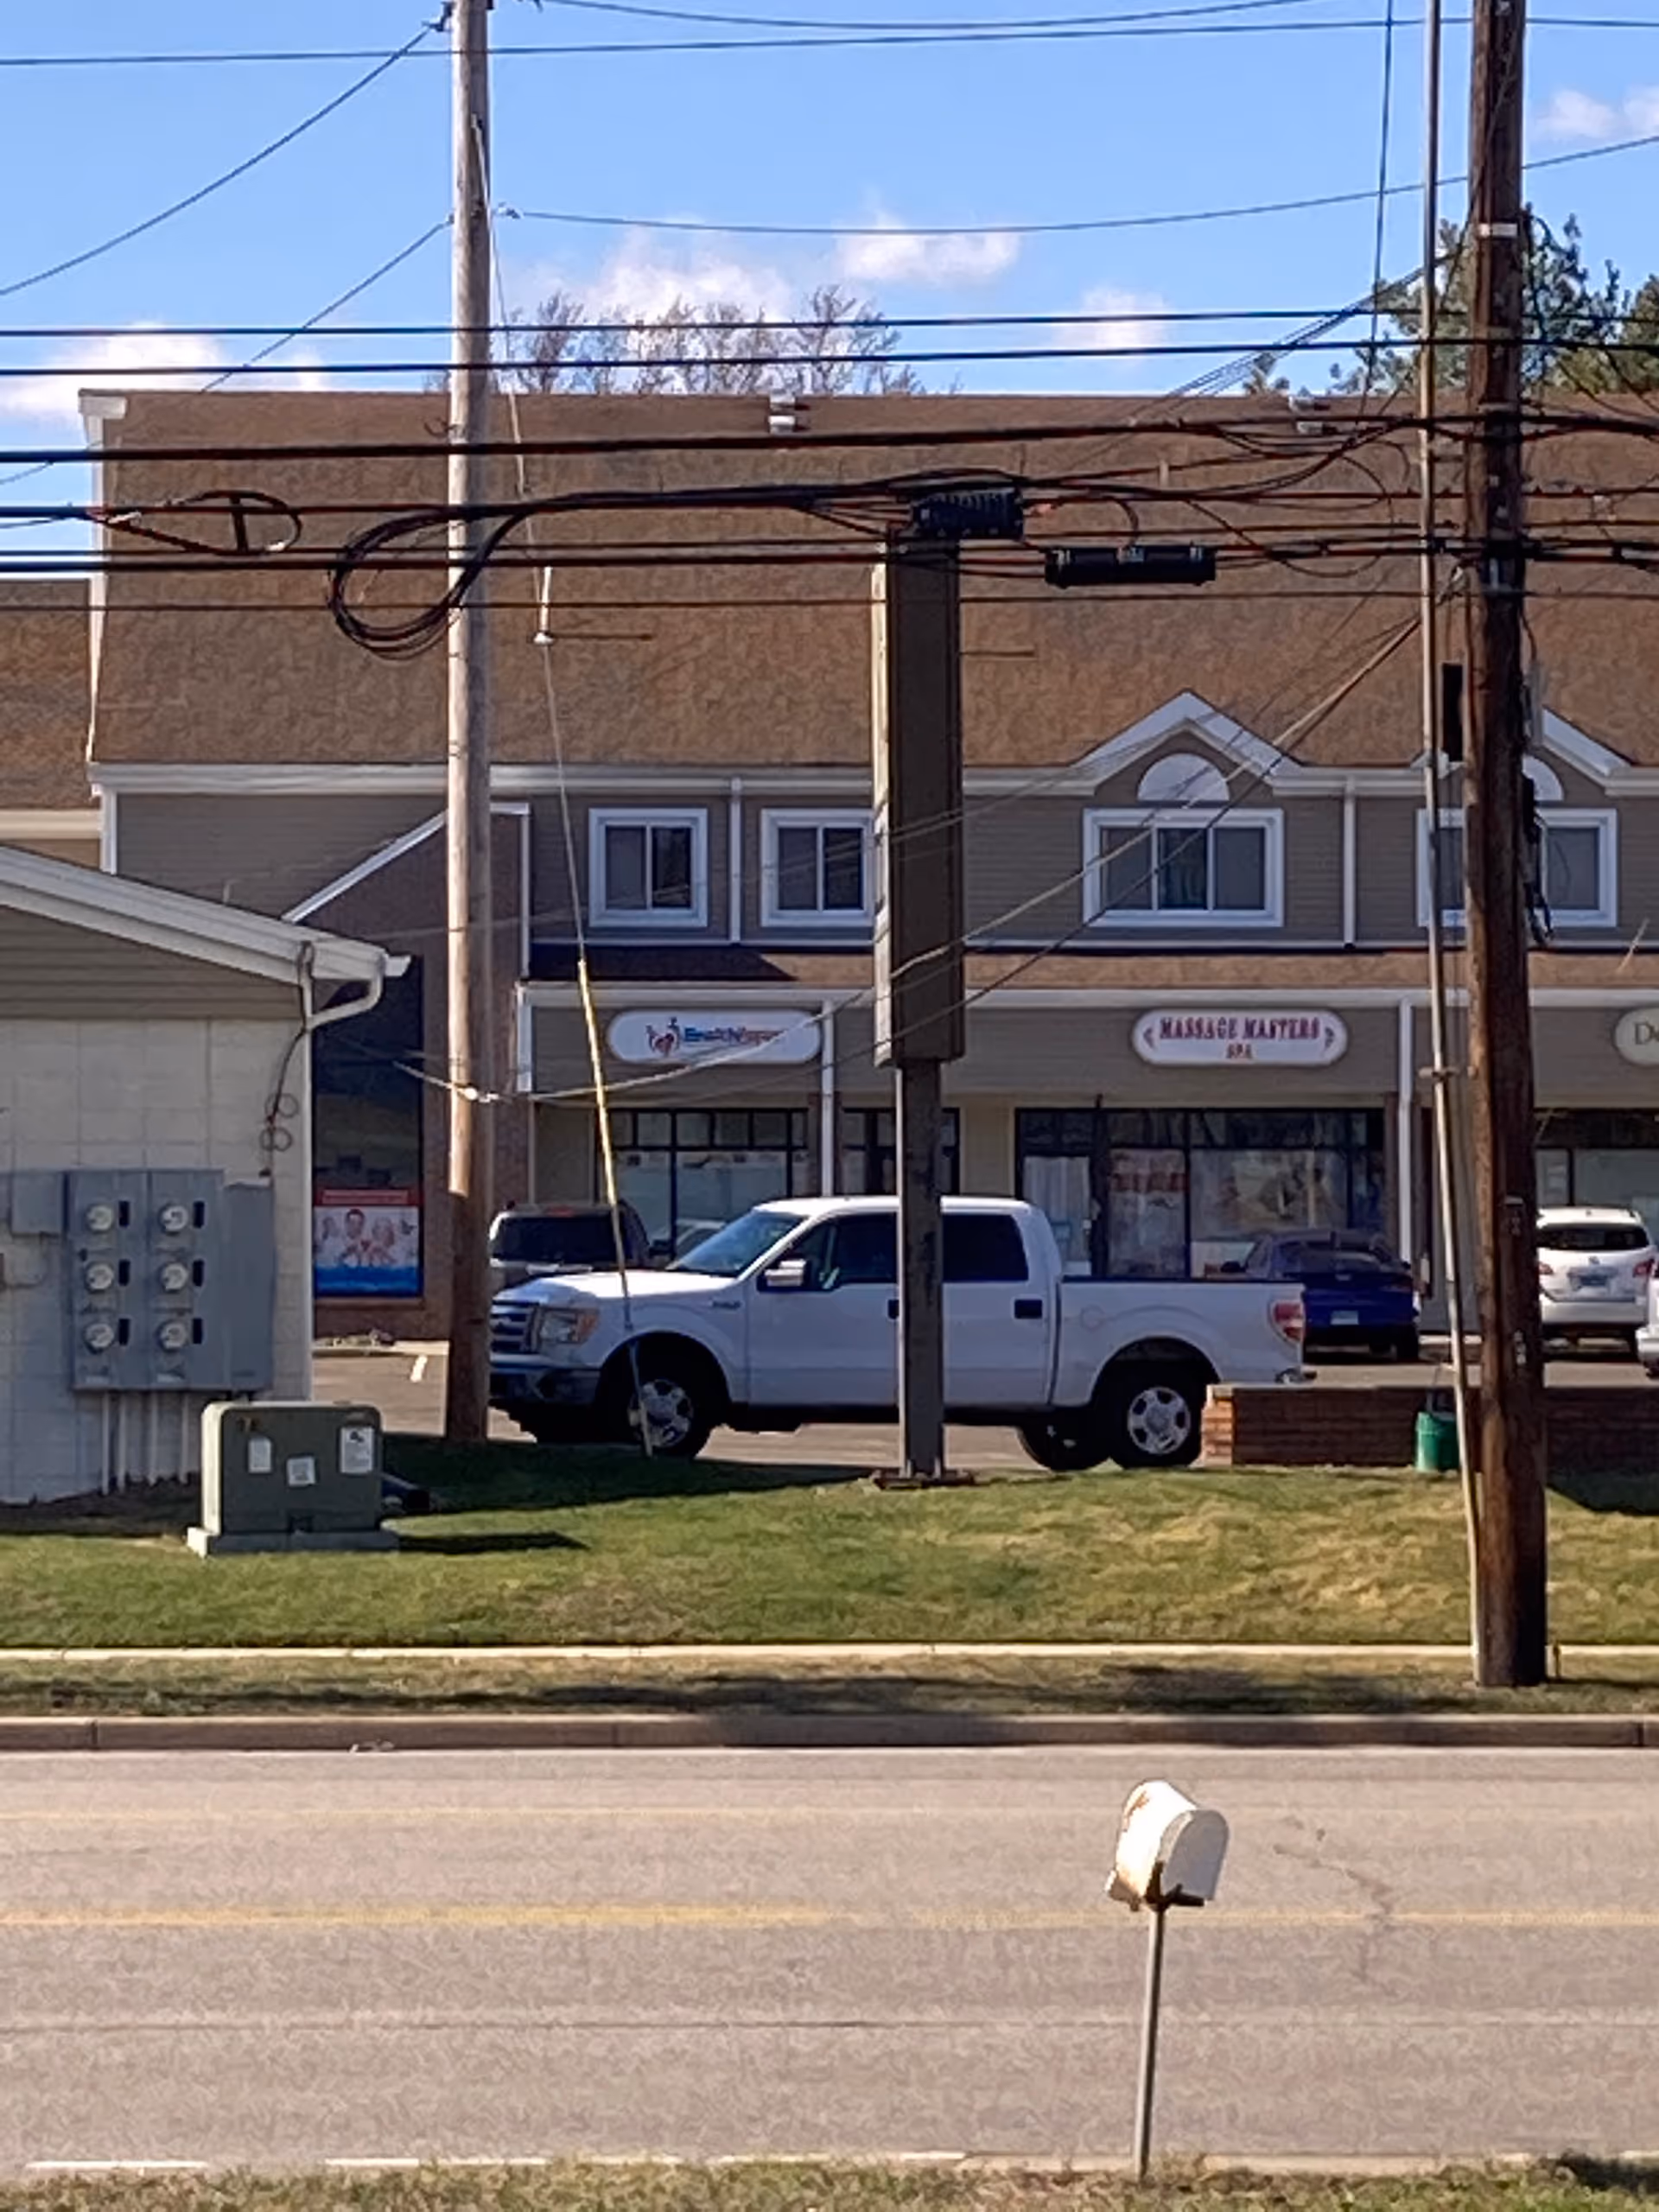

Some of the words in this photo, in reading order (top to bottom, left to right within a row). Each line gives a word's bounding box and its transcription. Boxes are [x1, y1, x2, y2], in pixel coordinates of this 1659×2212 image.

[1160, 1017, 1238, 1039] MASSAGE
[1243, 1017, 1320, 1039] MASTERS
[1225, 1043, 1253, 1058] SPA
